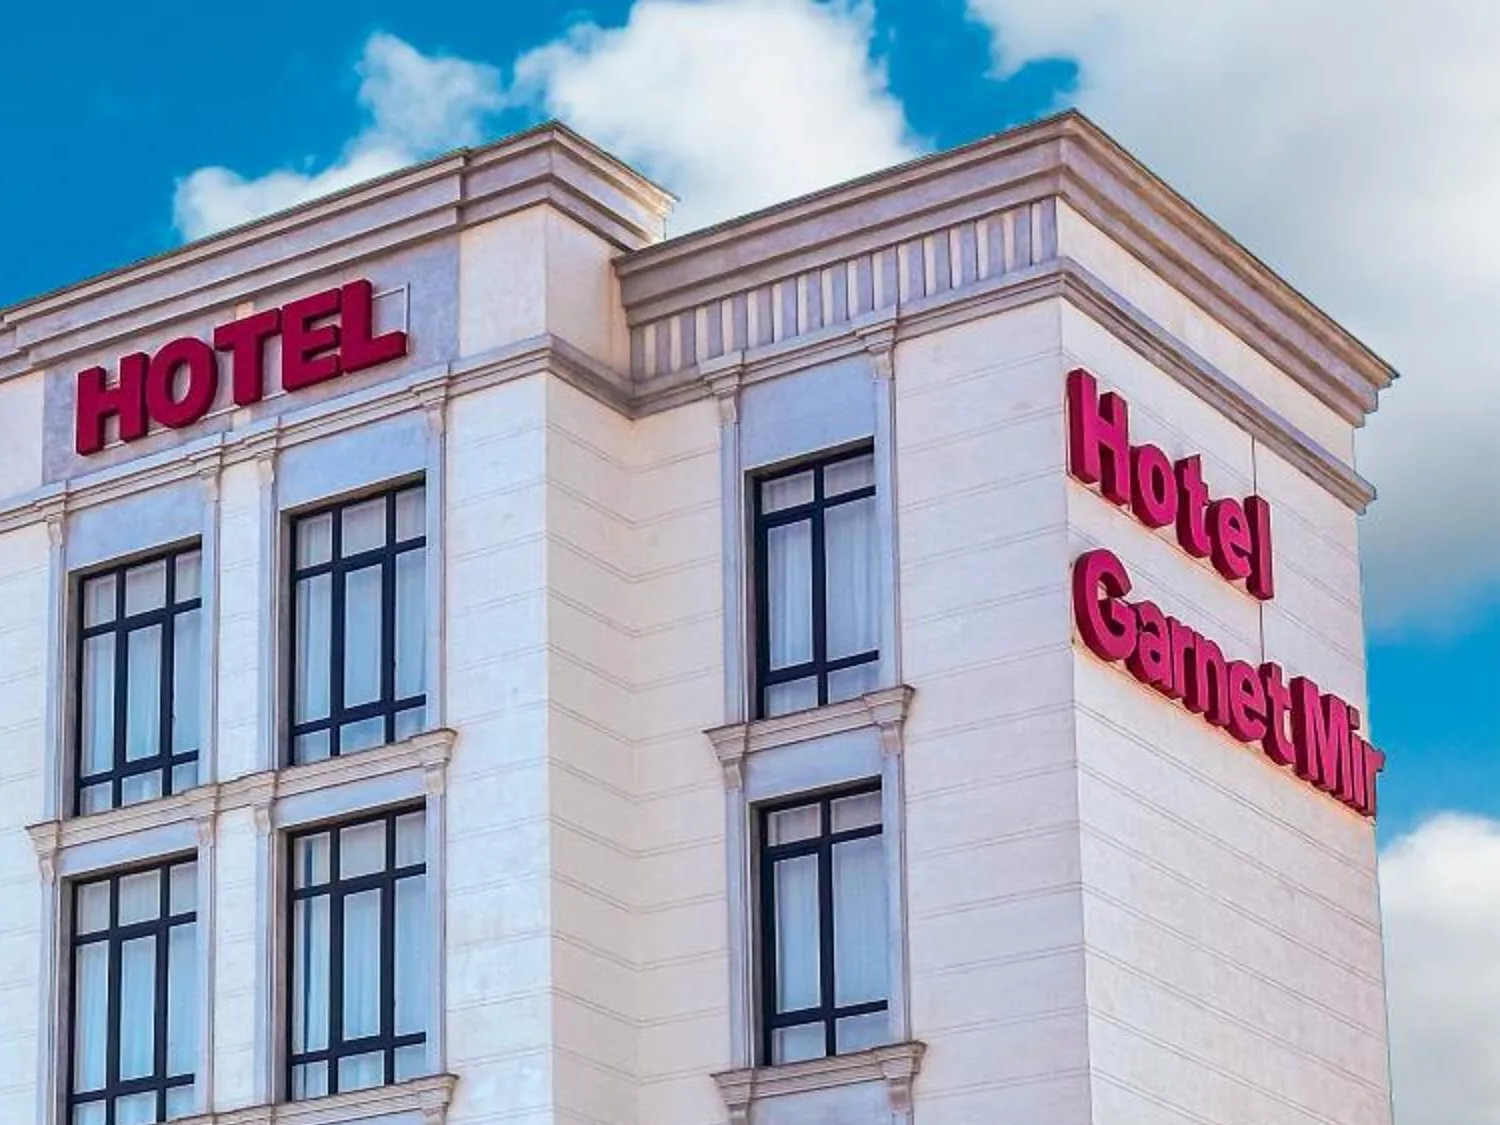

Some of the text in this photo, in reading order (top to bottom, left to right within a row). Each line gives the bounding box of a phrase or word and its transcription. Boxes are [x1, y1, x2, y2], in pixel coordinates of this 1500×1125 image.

[75, 278, 407, 456] HOTEL
[1067, 367, 1274, 600] Hotel
[1072, 549, 1385, 817] Garnet Mir
